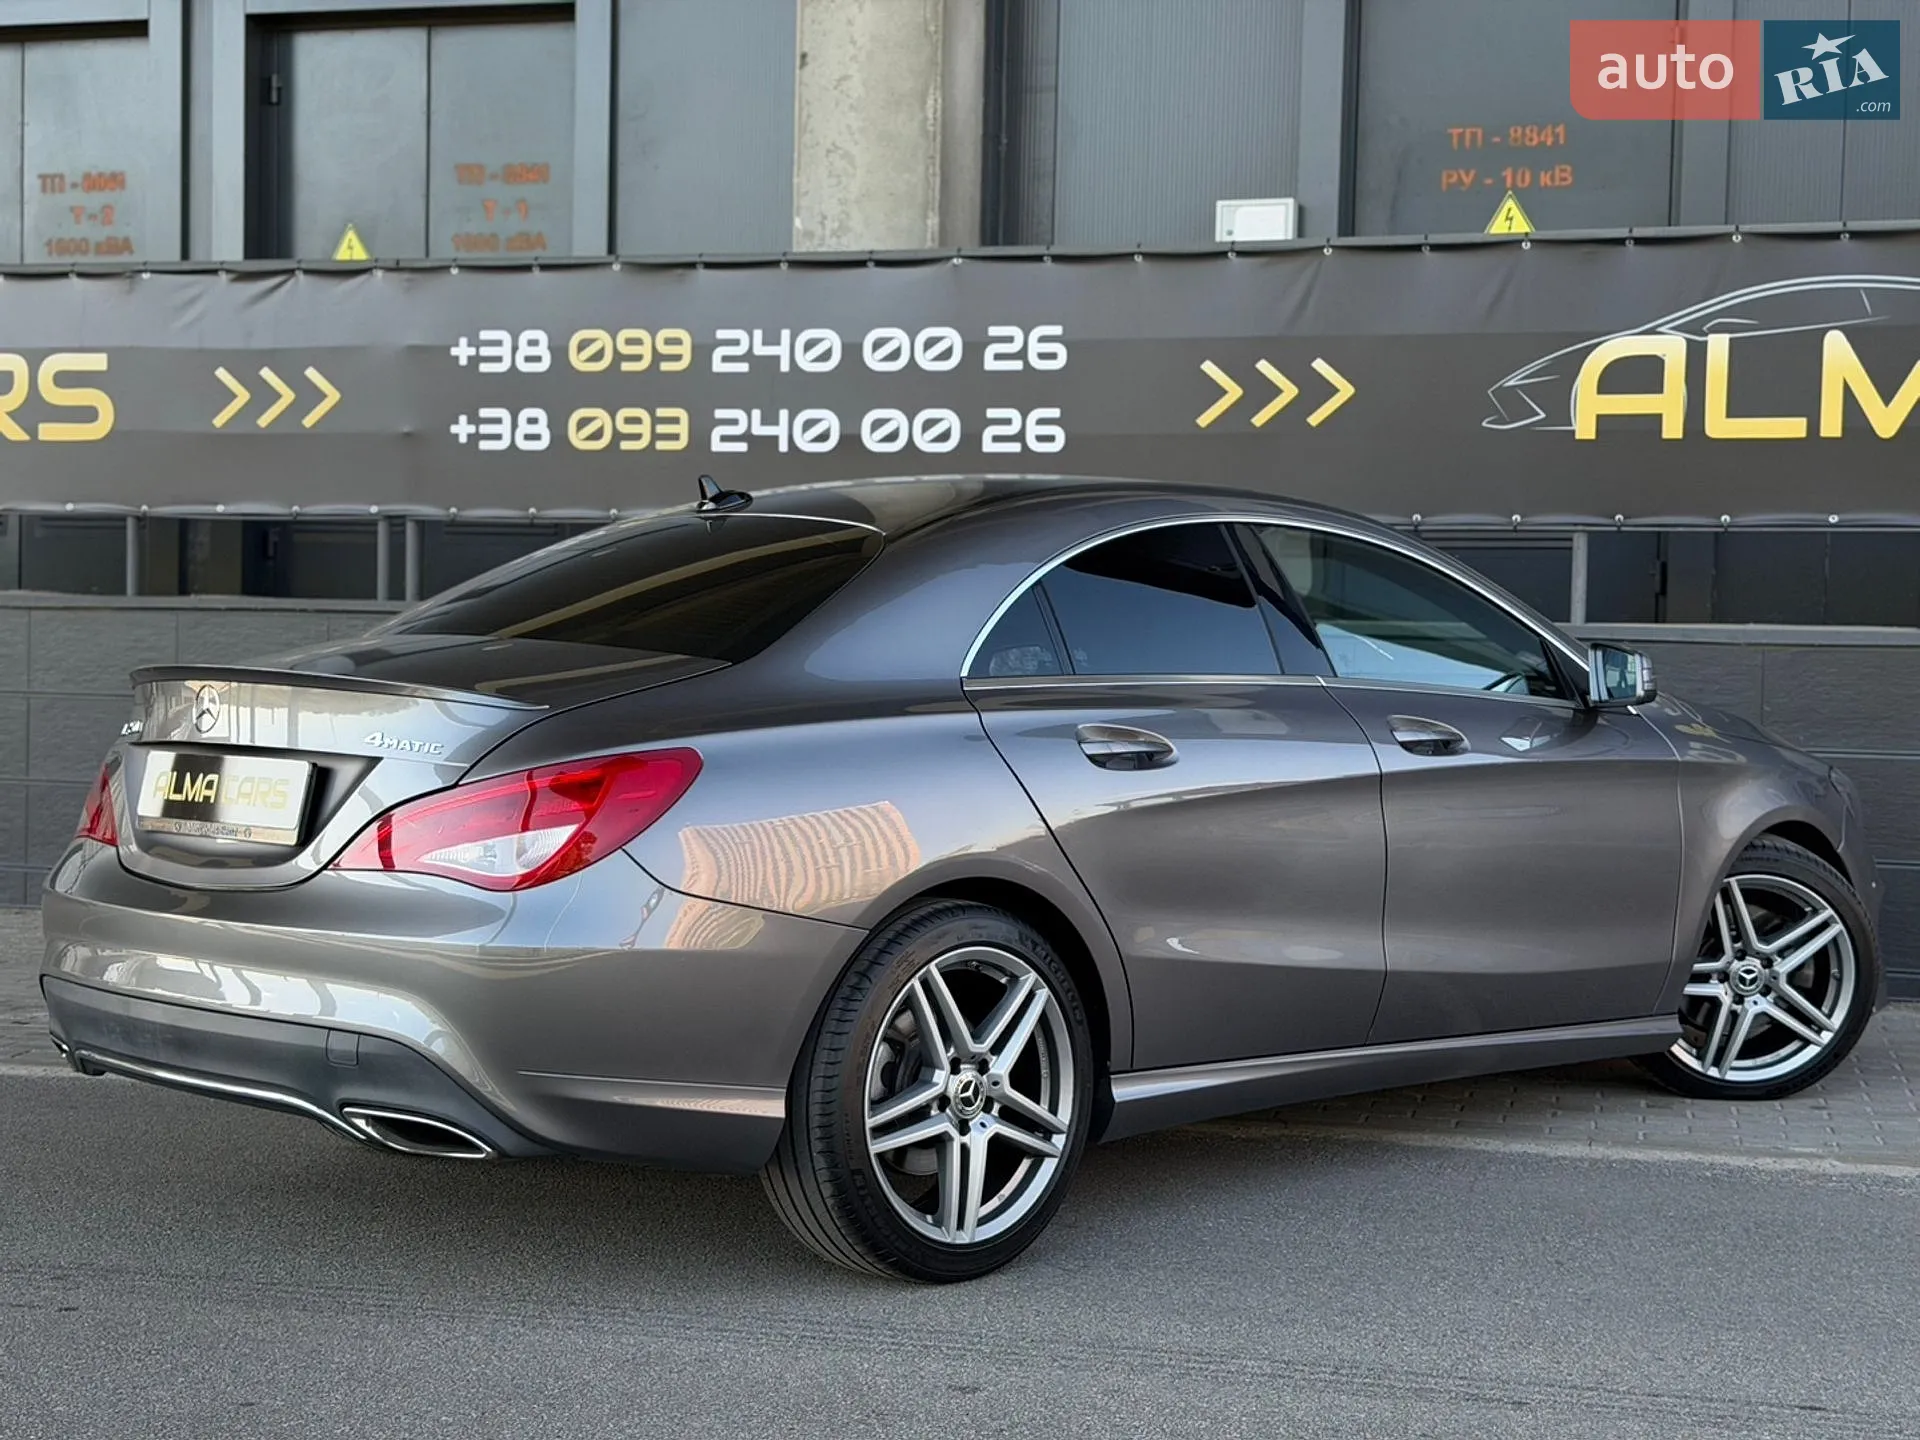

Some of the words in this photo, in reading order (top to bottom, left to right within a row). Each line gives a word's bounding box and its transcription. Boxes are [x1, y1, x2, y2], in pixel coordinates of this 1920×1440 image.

[1447, 128, 1483, 150] ТП
[1509, 125, 1566, 147] 8841
[1442, 169, 1476, 191] РУ
[1504, 166, 1531, 189] 10
[450, 330, 551, 373] +38
[568, 328, 693, 373] 099
[711, 327, 842, 373] 240
[862, 326, 963, 372] 00
[983, 324, 1068, 371] 26
[450, 407, 551, 451] +38
[568, 407, 690, 451] 093
[711, 408, 840, 453] 240
[860, 408, 962, 453] 00
[981, 407, 1067, 453] 26
[364, 731, 444, 755] 4MATIC
[153, 771, 219, 804] ALMA
[221, 774, 291, 812] CARS
